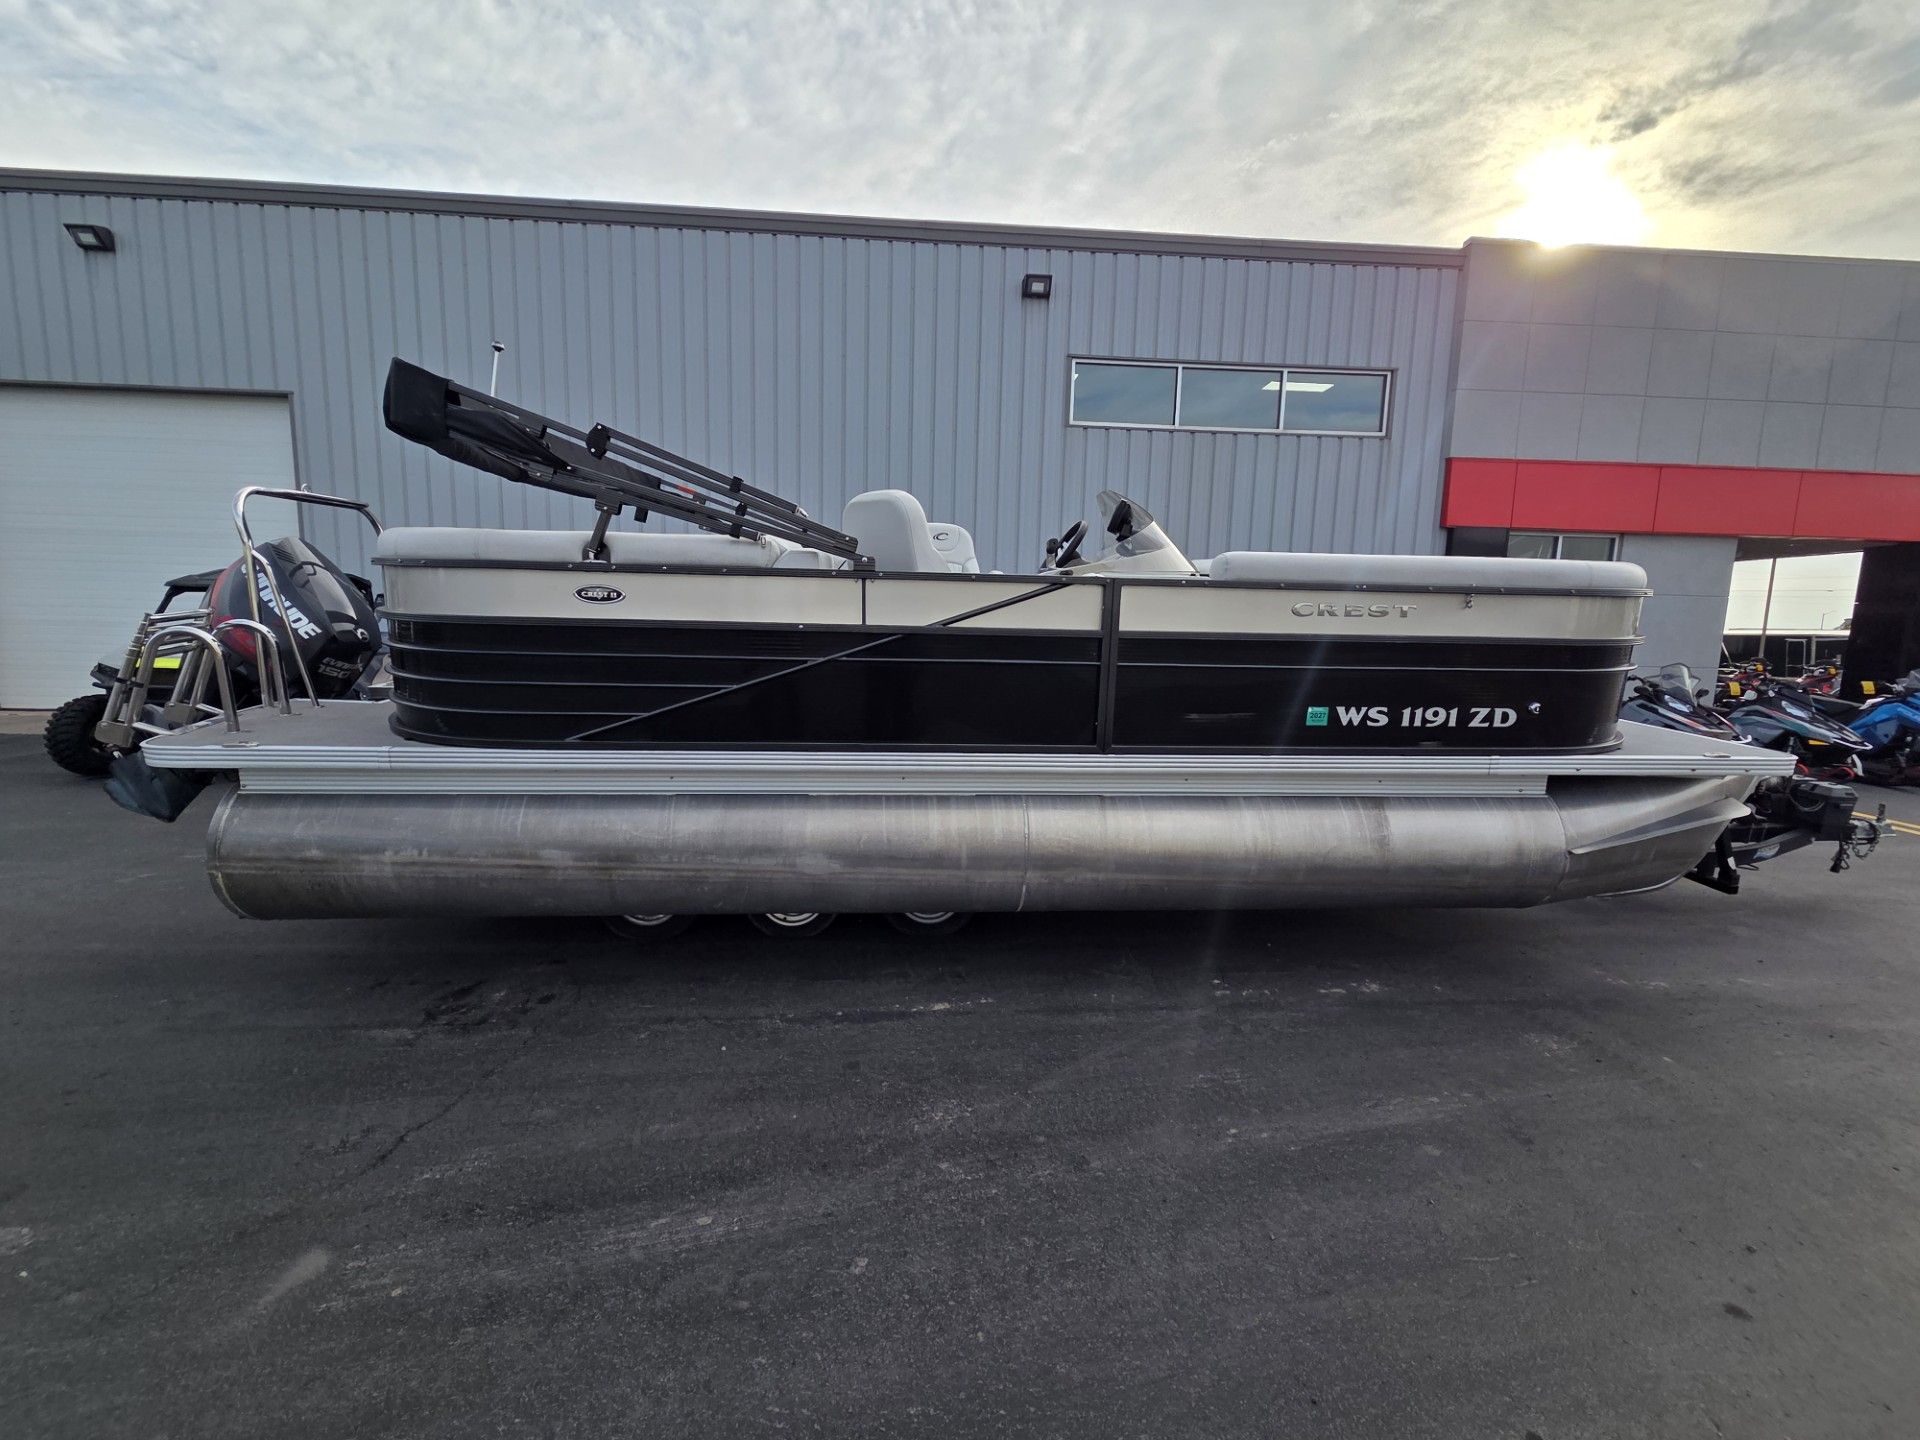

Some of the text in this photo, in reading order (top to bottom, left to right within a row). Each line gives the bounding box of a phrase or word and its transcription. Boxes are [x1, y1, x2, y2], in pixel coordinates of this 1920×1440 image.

[241, 562, 322, 639] INRUDE
[581, 591, 608, 599] CREST
[1291, 602, 1417, 618] CREST
[318, 664, 350, 679] 150
[1335, 705, 1518, 728] WS 1191 ZD
